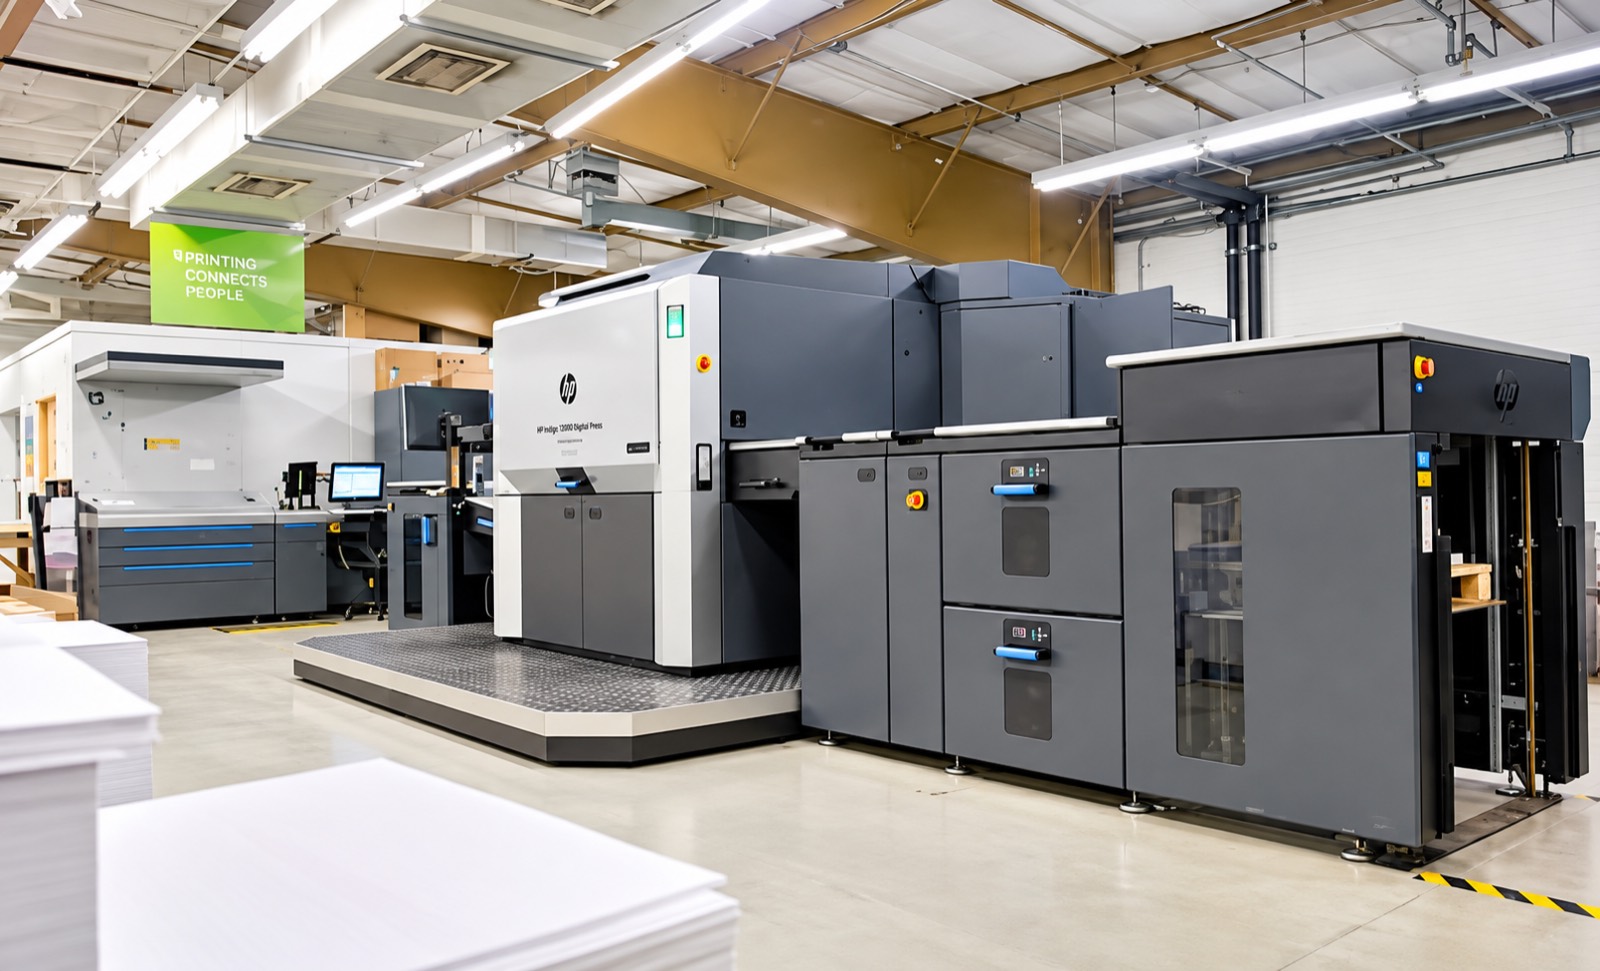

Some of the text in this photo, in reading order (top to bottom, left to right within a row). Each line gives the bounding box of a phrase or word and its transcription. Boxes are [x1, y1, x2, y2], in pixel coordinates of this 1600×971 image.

[185, 251, 257, 270] PRINTING
[185, 269, 268, 288] CONNECTS
[185, 285, 244, 301] PEOPLE
[560, 373, 577, 404] hp
[1494, 369, 1520, 423] hp
[537, 426, 543, 434] HP
[590, 421, 603, 430] Press
